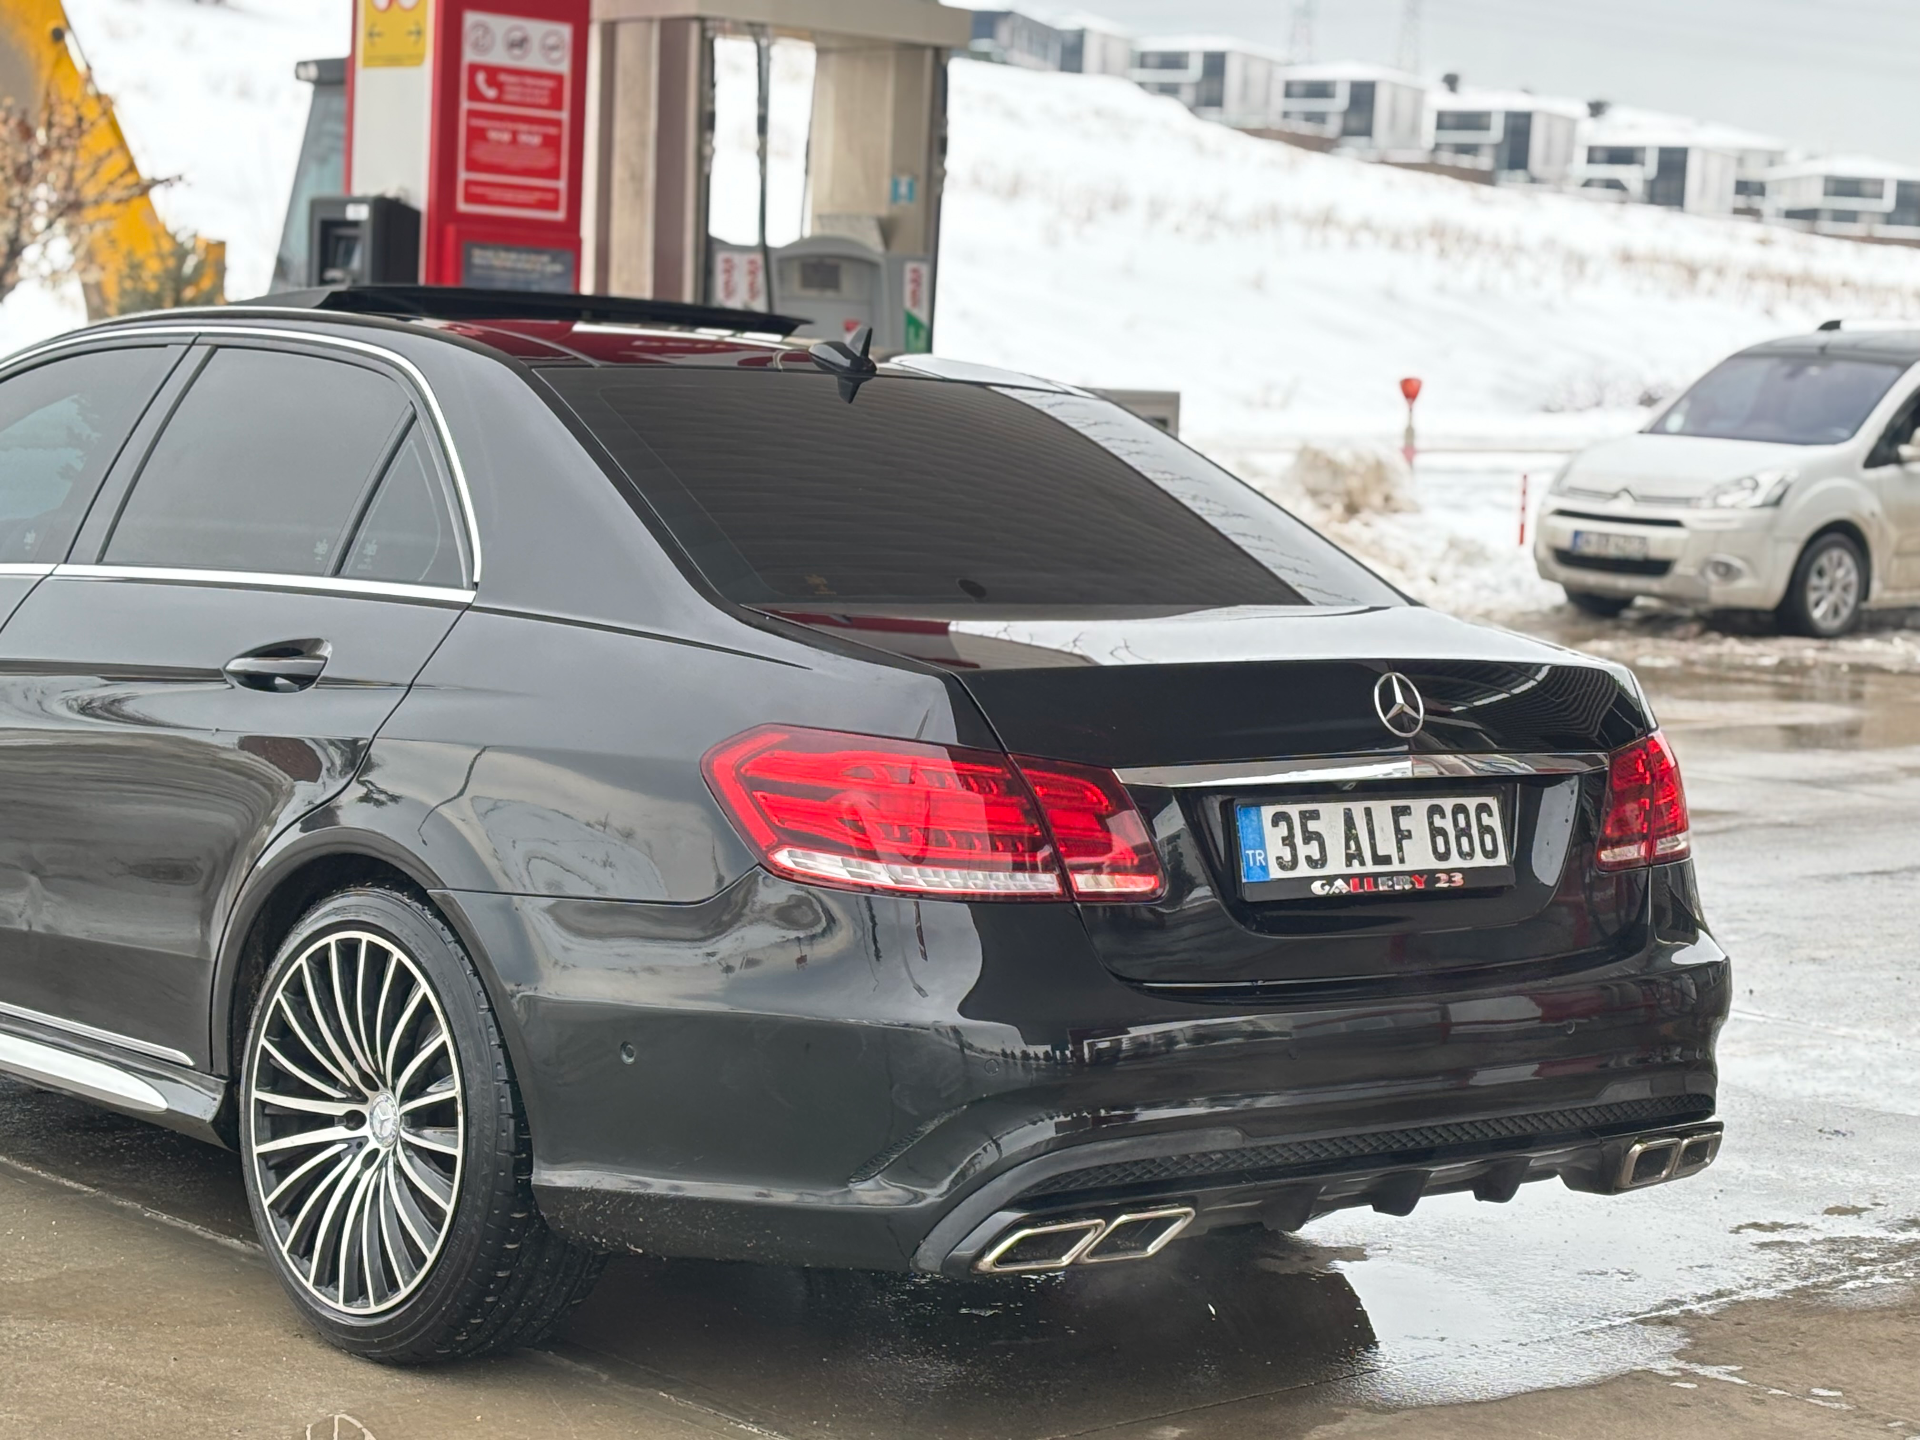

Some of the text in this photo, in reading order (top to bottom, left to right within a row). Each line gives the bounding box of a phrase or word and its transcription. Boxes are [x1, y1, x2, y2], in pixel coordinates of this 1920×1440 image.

[1271, 802, 1500, 871] 35 ALF 686
[1246, 850, 1266, 866] TR
[1311, 872, 1465, 895] GALLERY 23
